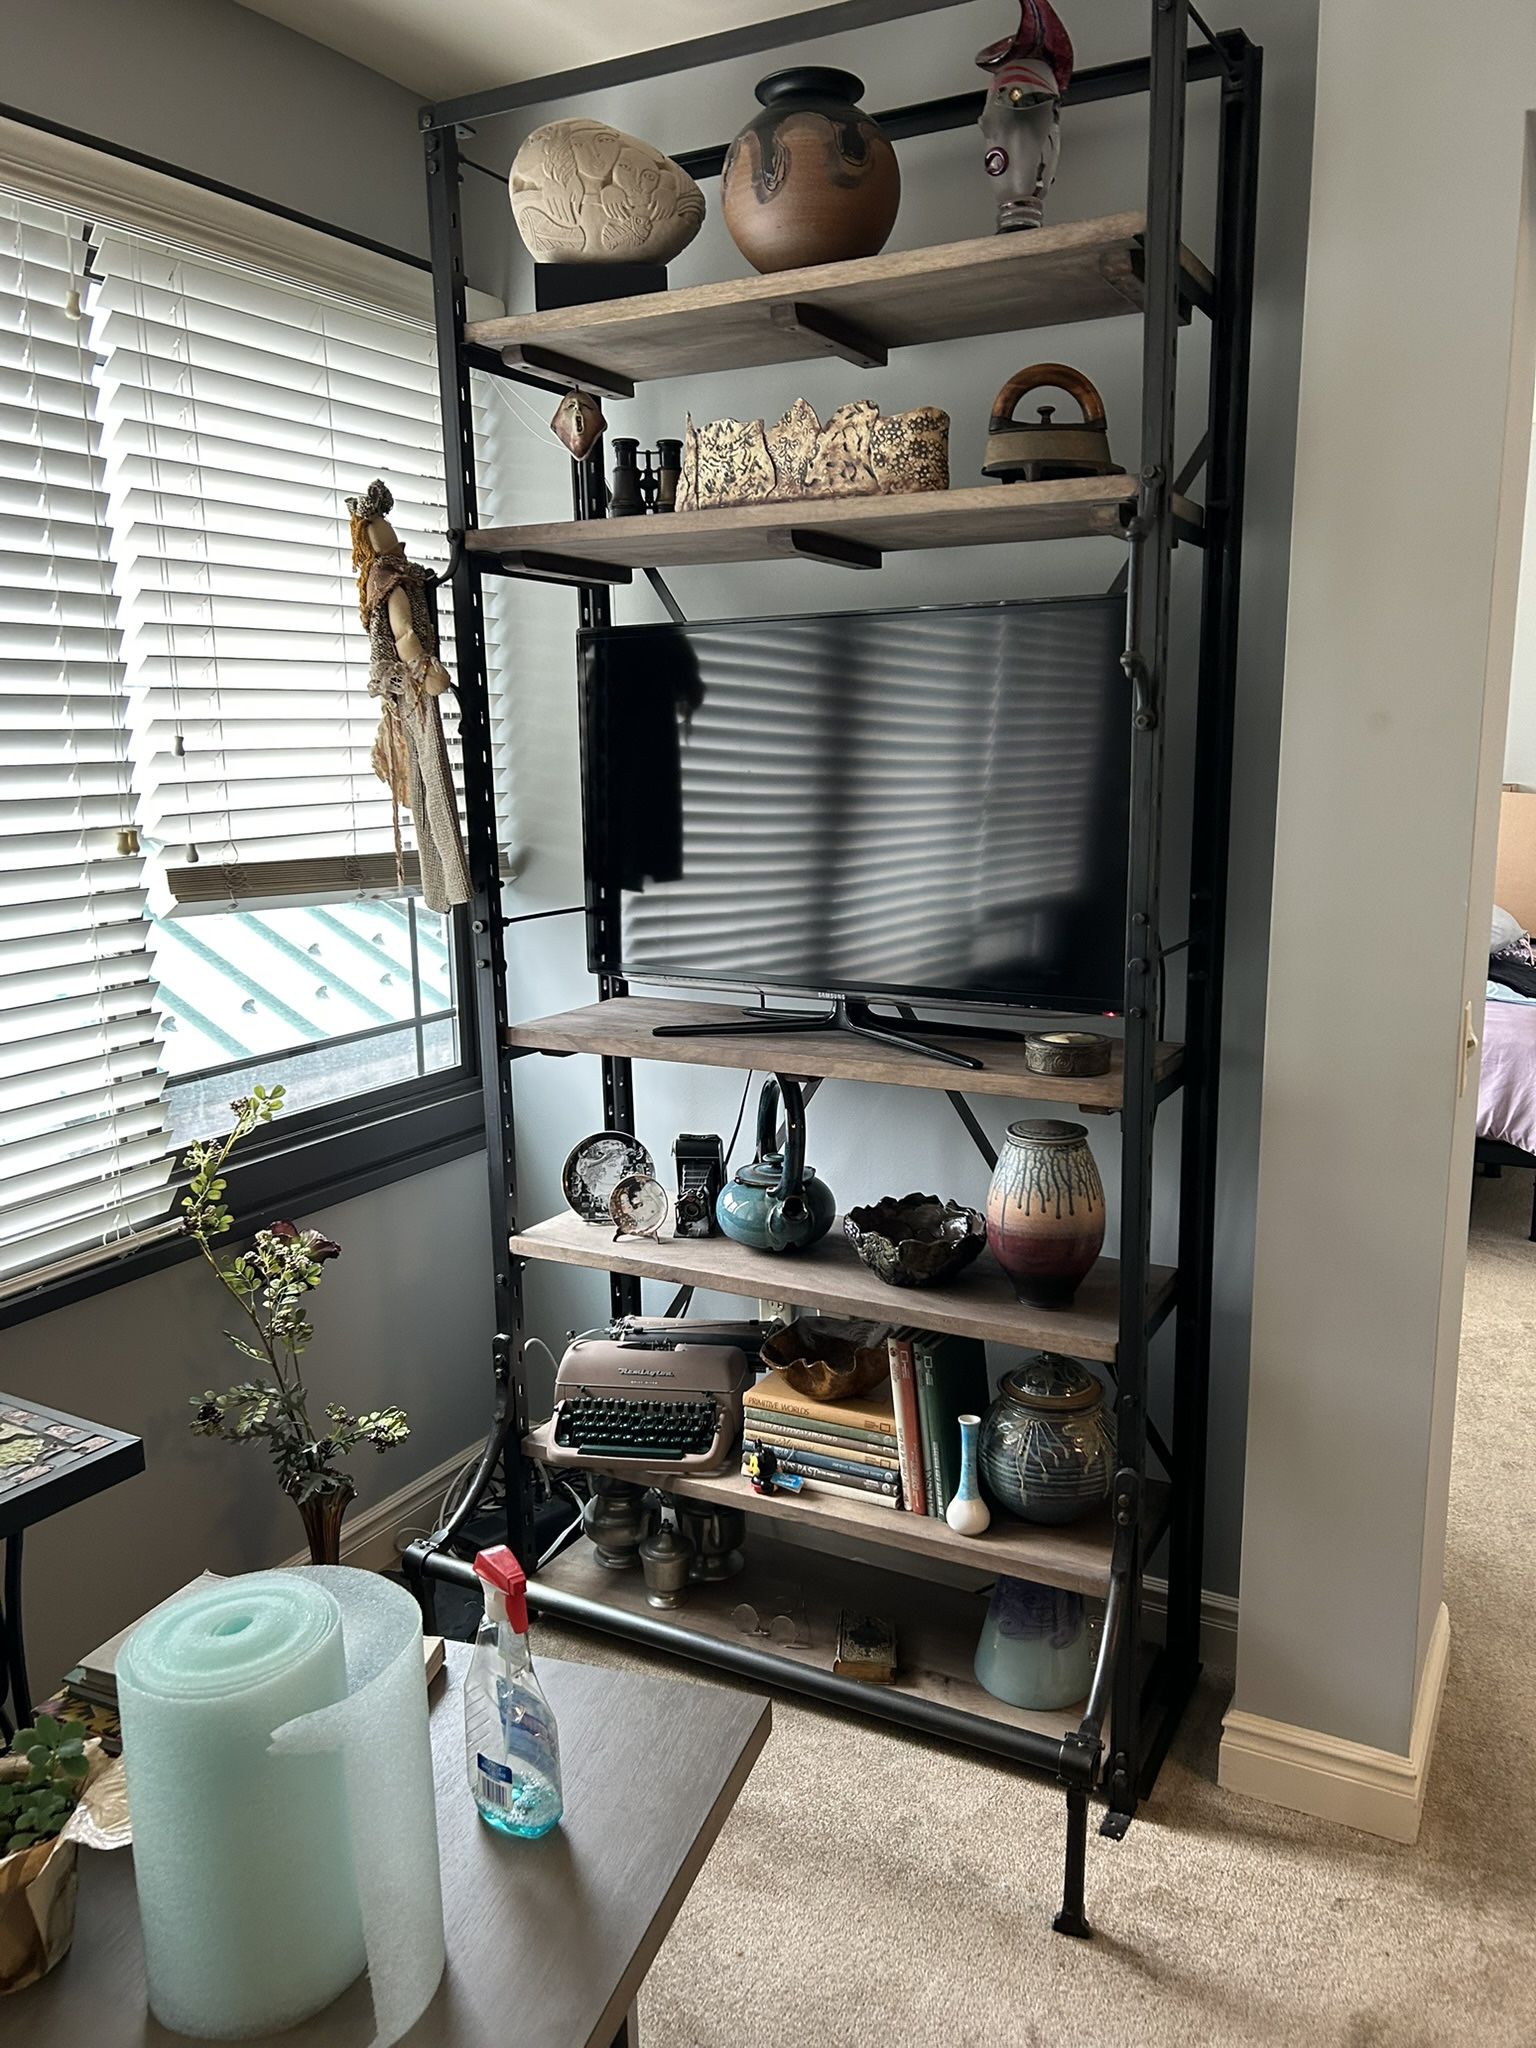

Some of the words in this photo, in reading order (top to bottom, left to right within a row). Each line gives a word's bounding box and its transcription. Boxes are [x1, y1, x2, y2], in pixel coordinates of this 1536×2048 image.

[818, 991, 846, 1000] SAMSUNG
[618, 1368, 674, 1377] Remington
[748, 1397, 779, 1409] PRIMITIVE
[781, 1403, 810, 1415] WORLDS
[797, 1464, 819, 1477] PAST
